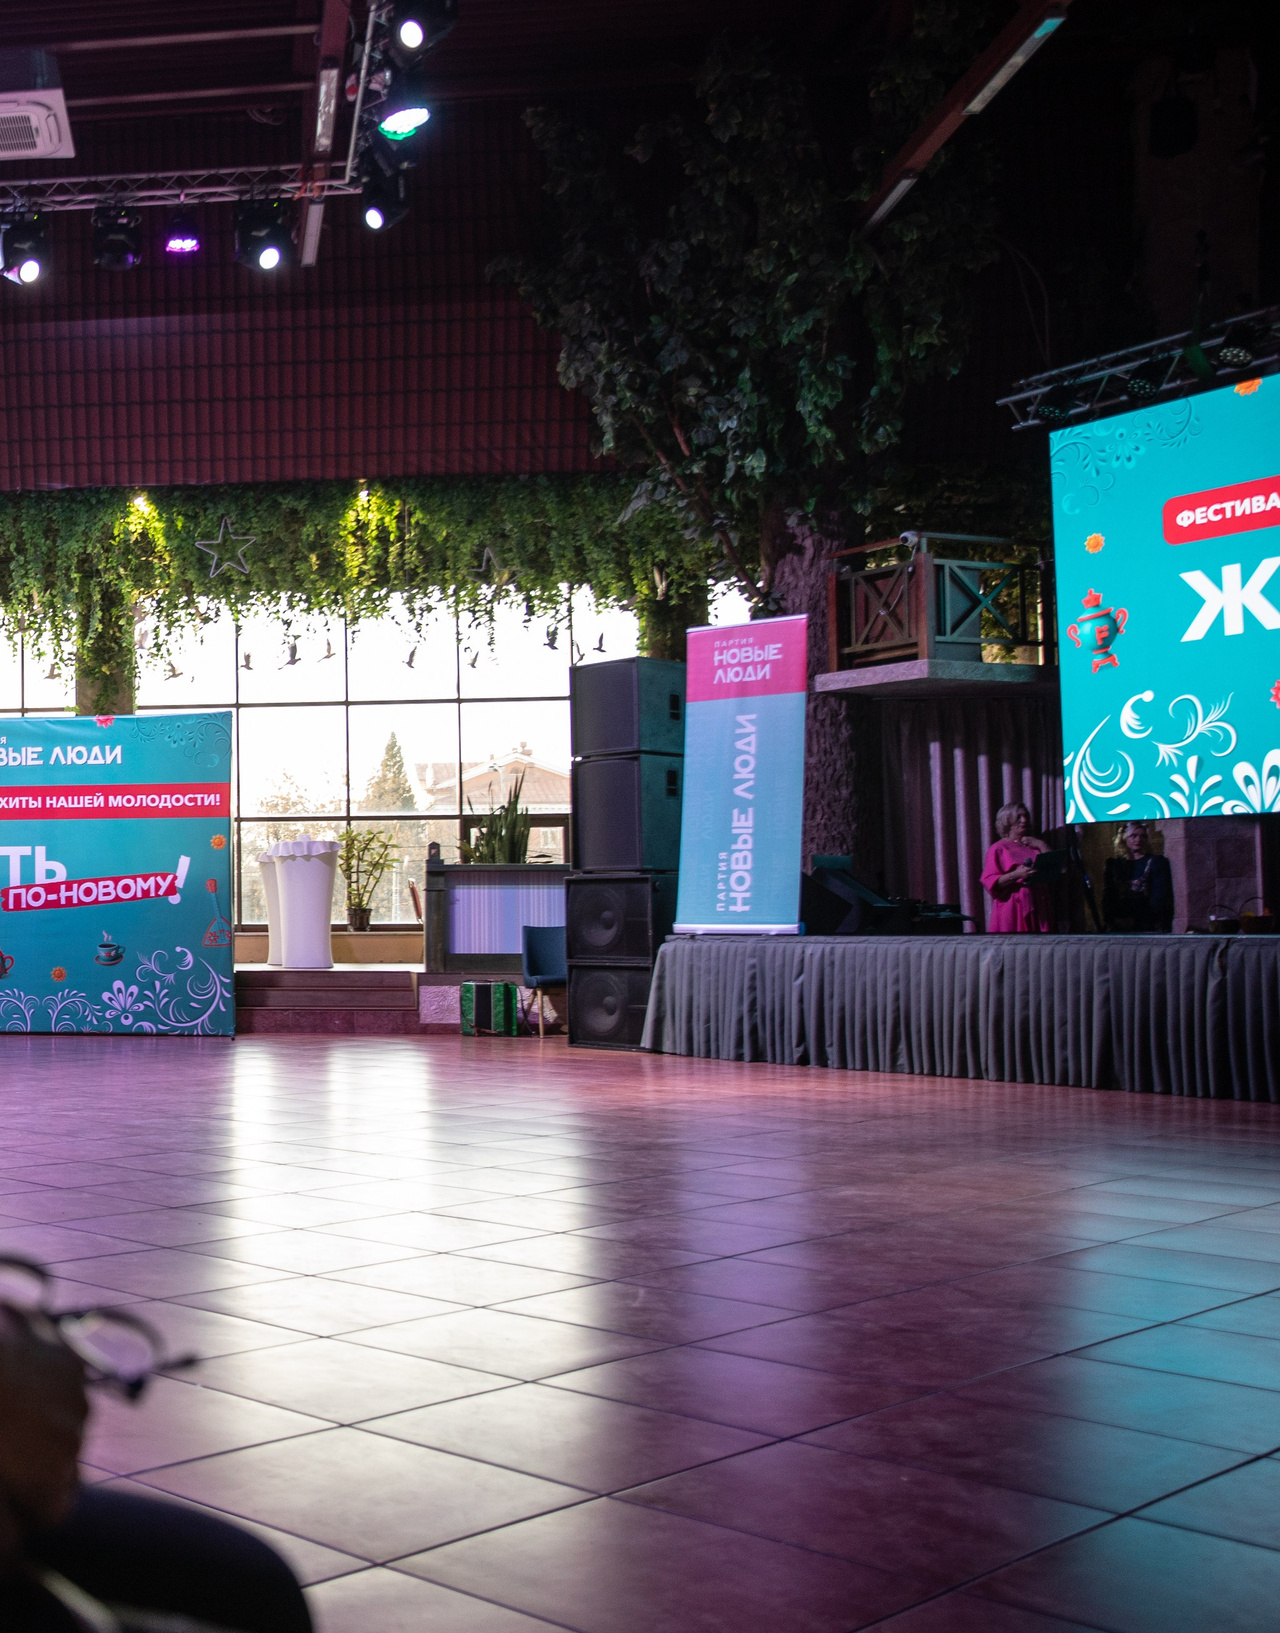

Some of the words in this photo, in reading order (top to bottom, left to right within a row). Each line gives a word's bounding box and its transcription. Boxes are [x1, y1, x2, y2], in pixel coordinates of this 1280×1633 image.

[713, 637, 754, 648] ПАРТИЯ
[713, 643, 783, 666] НОВЫЕ
[713, 663, 771, 684] ЛЮДИ
[49, 745, 122, 765] ЛЮДИ
[733, 713, 757, 800] ЛЮДИ
[46, 793, 105, 808] НАШЕЙ
[108, 793, 221, 809] МОЛОДОСТИ!
[729, 807, 754, 912] НОВЫЕ
[716, 852, 728, 911] ПАРТИЯ
